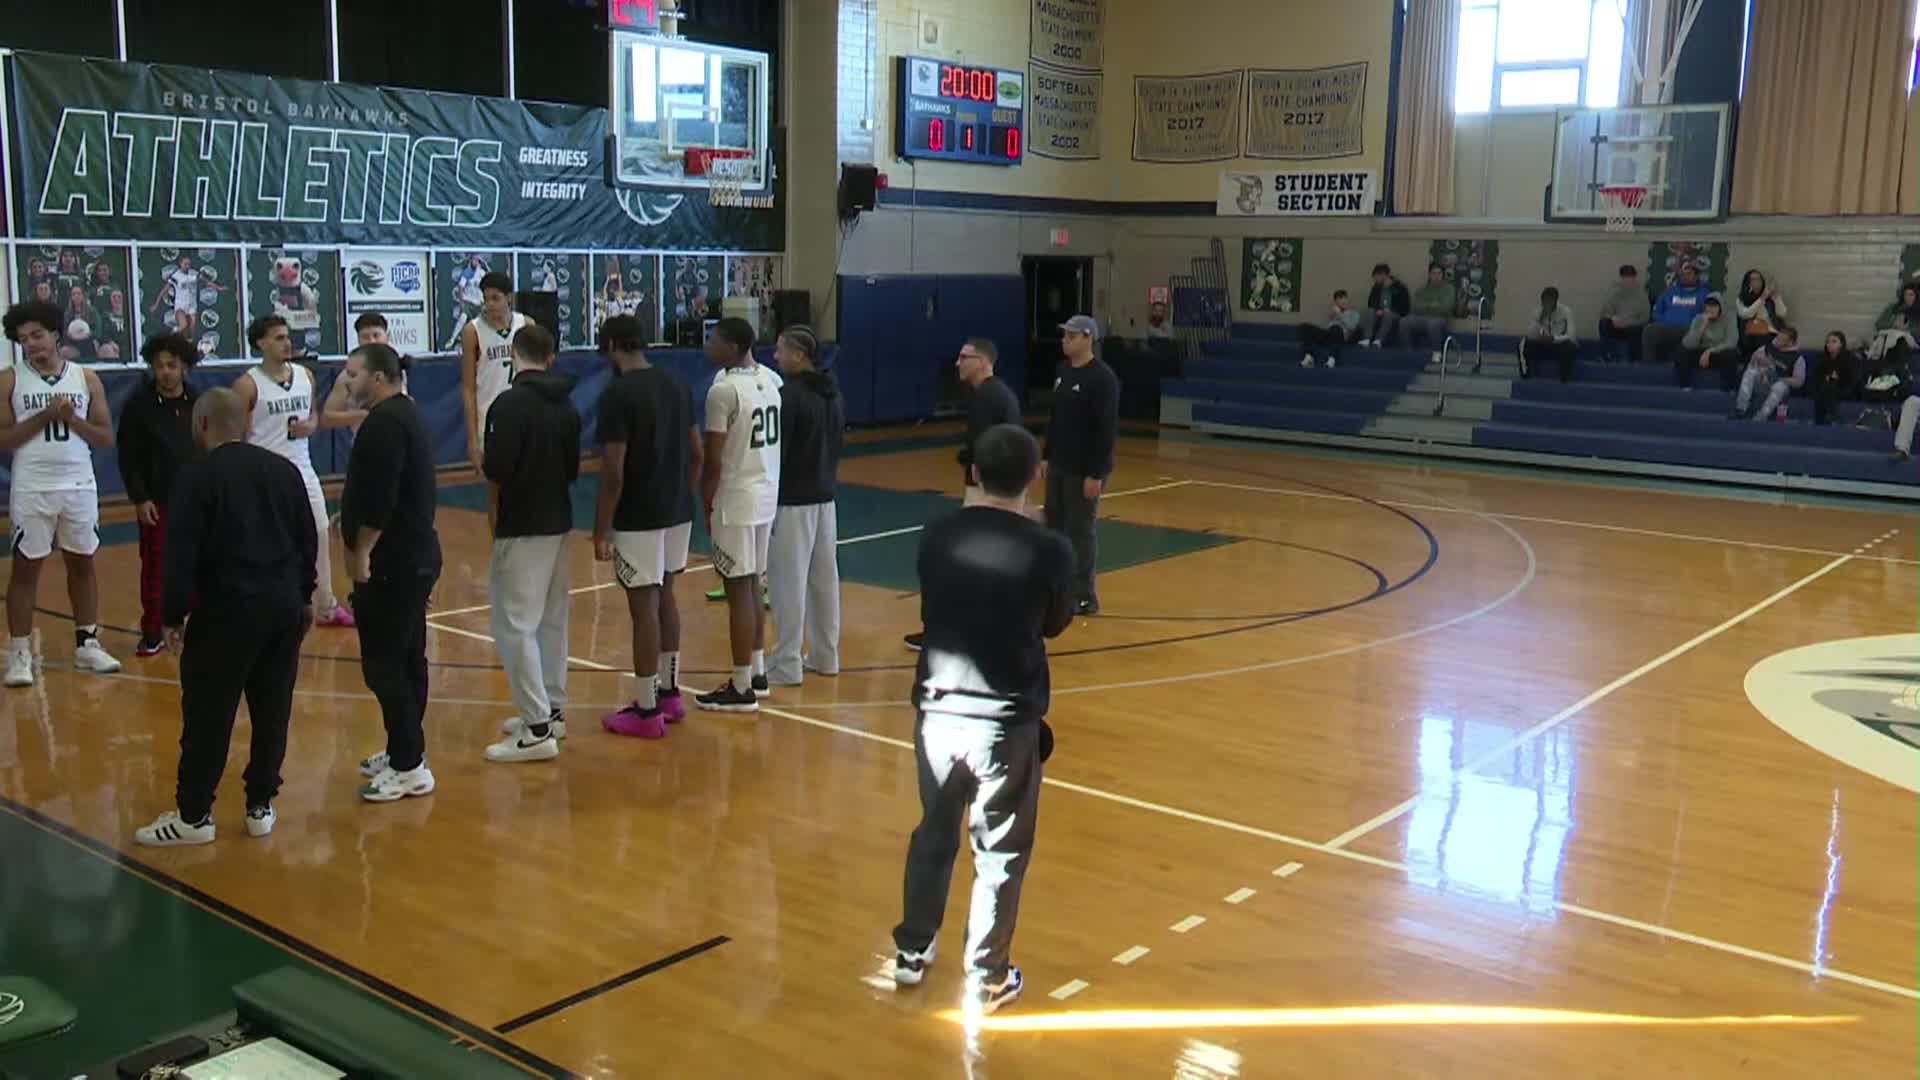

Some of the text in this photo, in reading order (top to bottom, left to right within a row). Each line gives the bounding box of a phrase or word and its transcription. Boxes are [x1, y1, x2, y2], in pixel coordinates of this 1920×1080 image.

[1053, 43, 1081, 59] 2000
[940, 66, 994, 102] 20:00
[1038, 76, 1095, 97] SOFTBALL
[163, 91, 408, 126] BRISTOL BAYHAWKS
[914, 101, 951, 114] BAYHAWKS
[1263, 91, 1349, 109] STATE CHAMPIONS
[1167, 116, 1206, 130] 2017
[1283, 112, 1324, 126] 2017
[929, 118, 1019, 158] 0 1 0
[1051, 134, 1080, 149] 2002
[519, 146, 588, 167] GREATNESS
[39, 107, 502, 226] ATHLETICS
[521, 181, 586, 200] INTEGRITY
[1275, 173, 1368, 191] STUDENT
[1278, 194, 1363, 211] SECTION
[751, 405, 779, 448] 20
